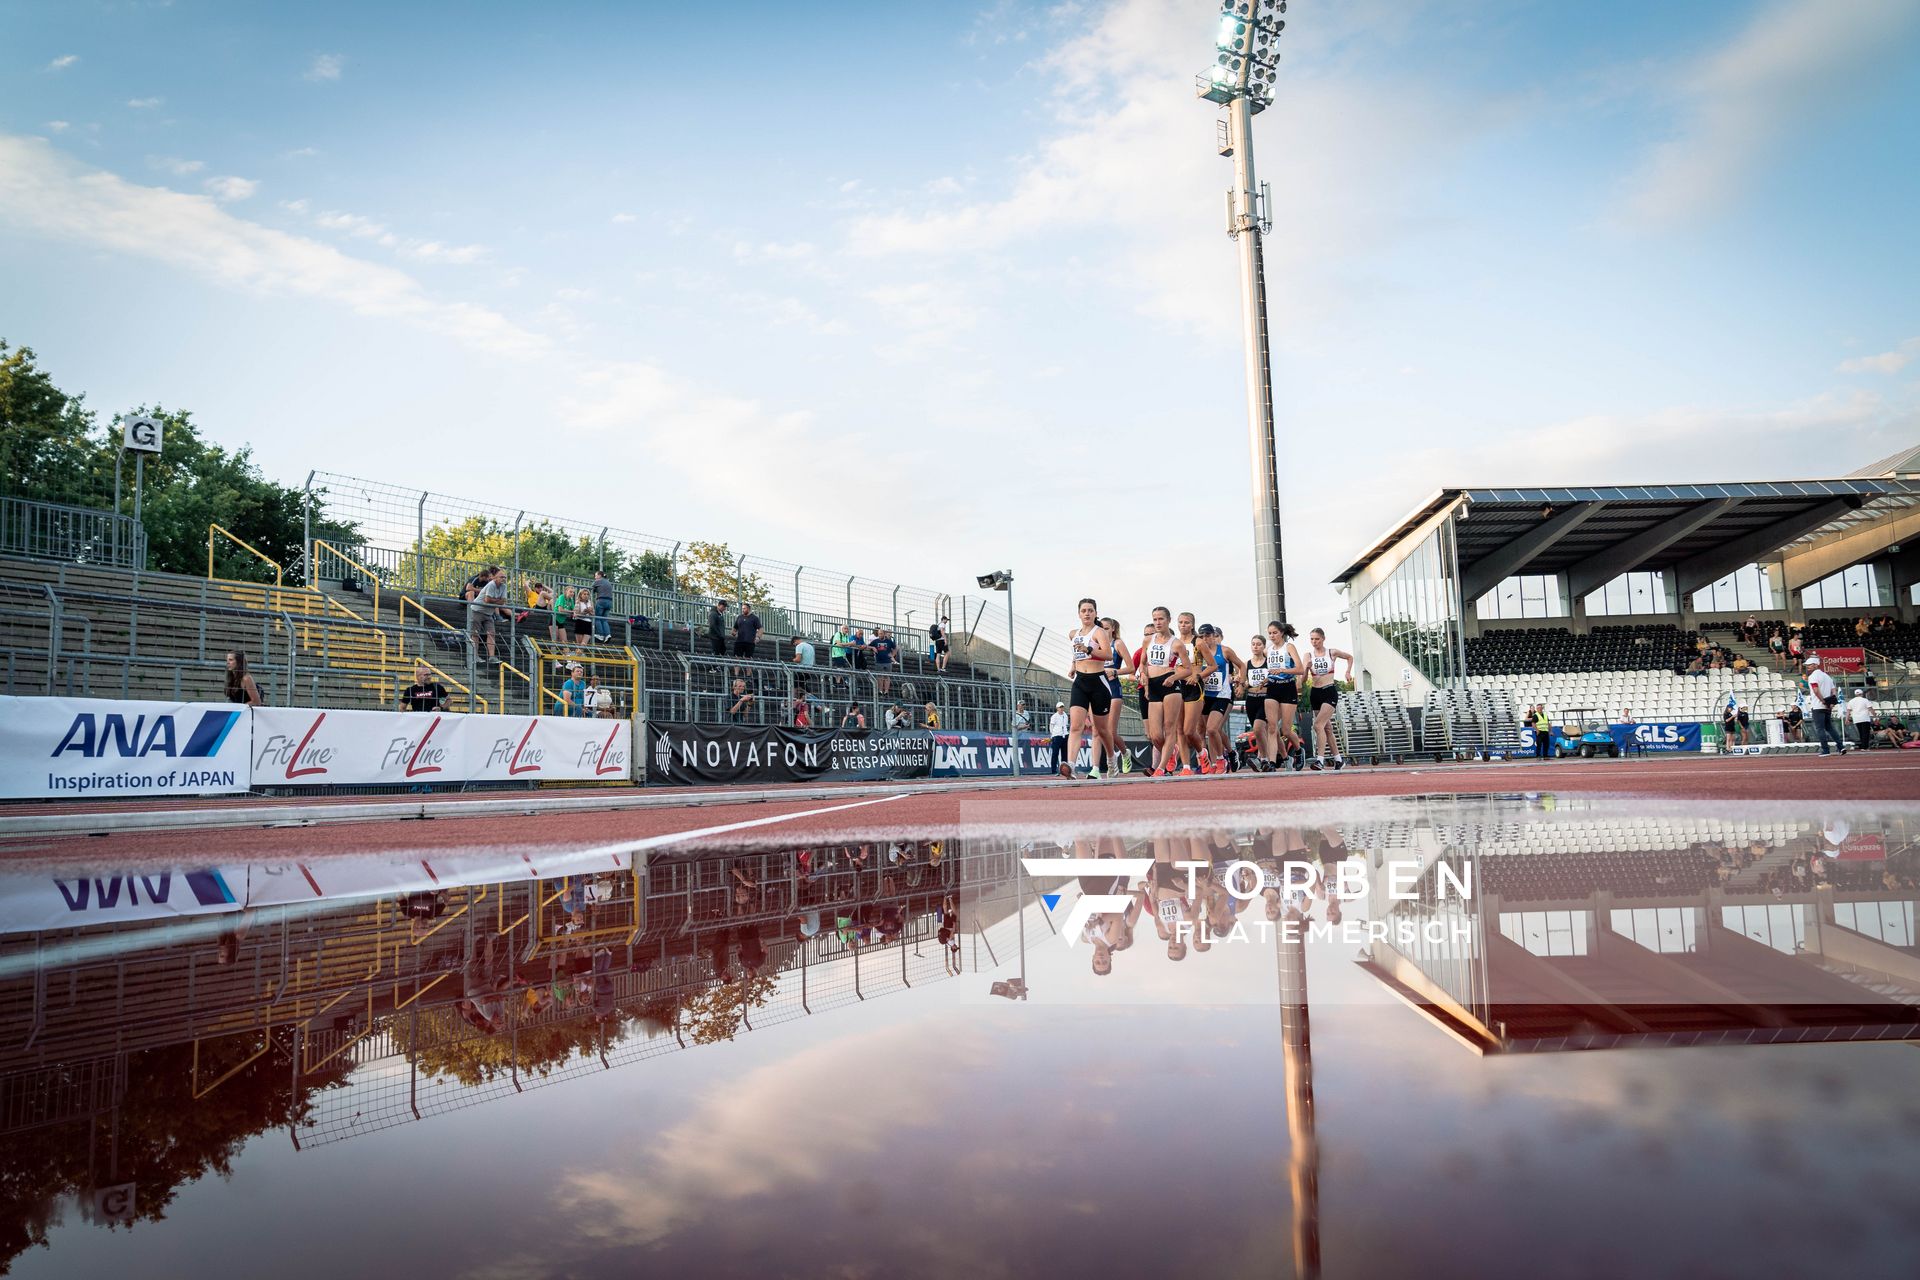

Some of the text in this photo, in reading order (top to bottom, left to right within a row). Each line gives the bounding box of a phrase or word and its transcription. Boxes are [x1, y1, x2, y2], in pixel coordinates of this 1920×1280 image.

[132, 421, 155, 446] G
[1150, 651, 1166, 660] 110
[51, 713, 177, 757] ANA
[255, 712, 333, 779] FitLine
[380, 716, 445, 778] FitLine
[486, 719, 543, 775] FitLine
[831, 737, 929, 752] GEGEN SCHMERZEN
[577, 723, 625, 776] FitLine
[682, 740, 817, 767] NOVAFON
[831, 755, 928, 769] & VERSPANNUNGEN
[49, 771, 235, 792] Inspiration of JAPAN
